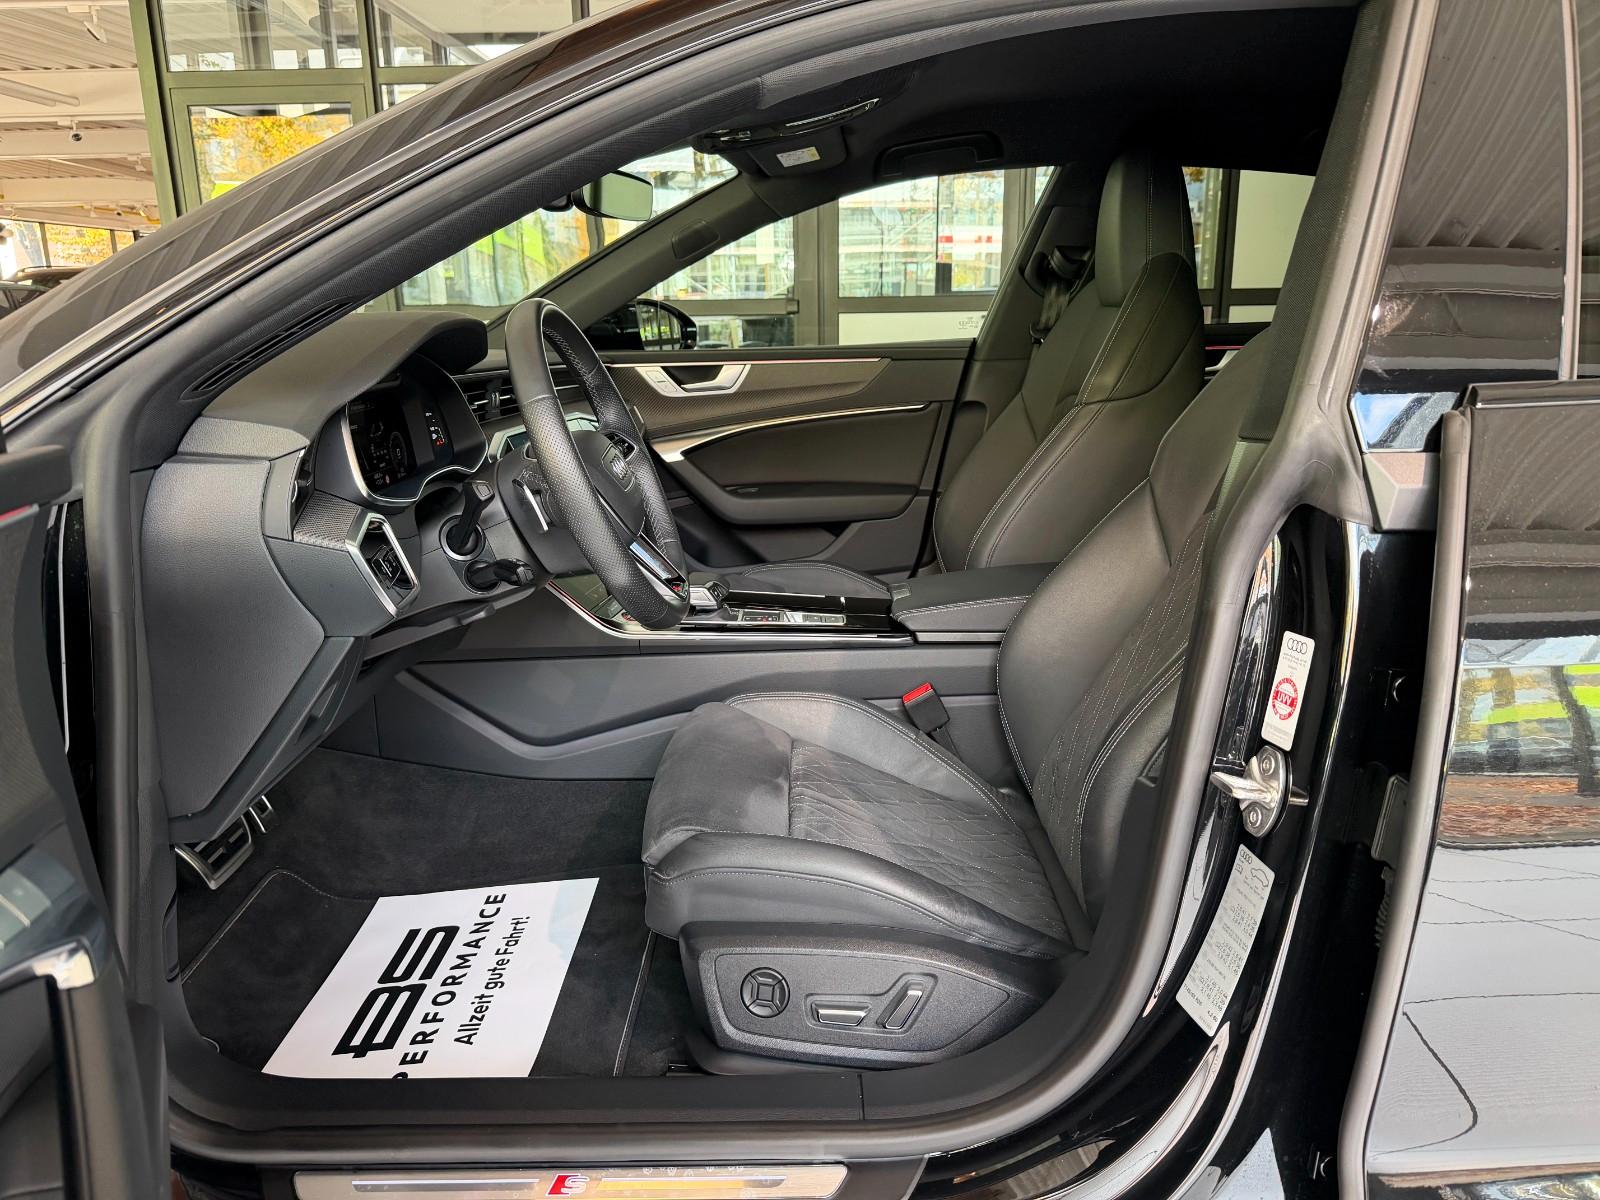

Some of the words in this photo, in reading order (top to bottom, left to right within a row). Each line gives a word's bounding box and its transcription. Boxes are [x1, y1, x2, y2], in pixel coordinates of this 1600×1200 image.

[494, 916, 530, 957] Fahrt!
[484, 957, 511, 990] gute
[453, 992, 494, 1046] Allzeit
